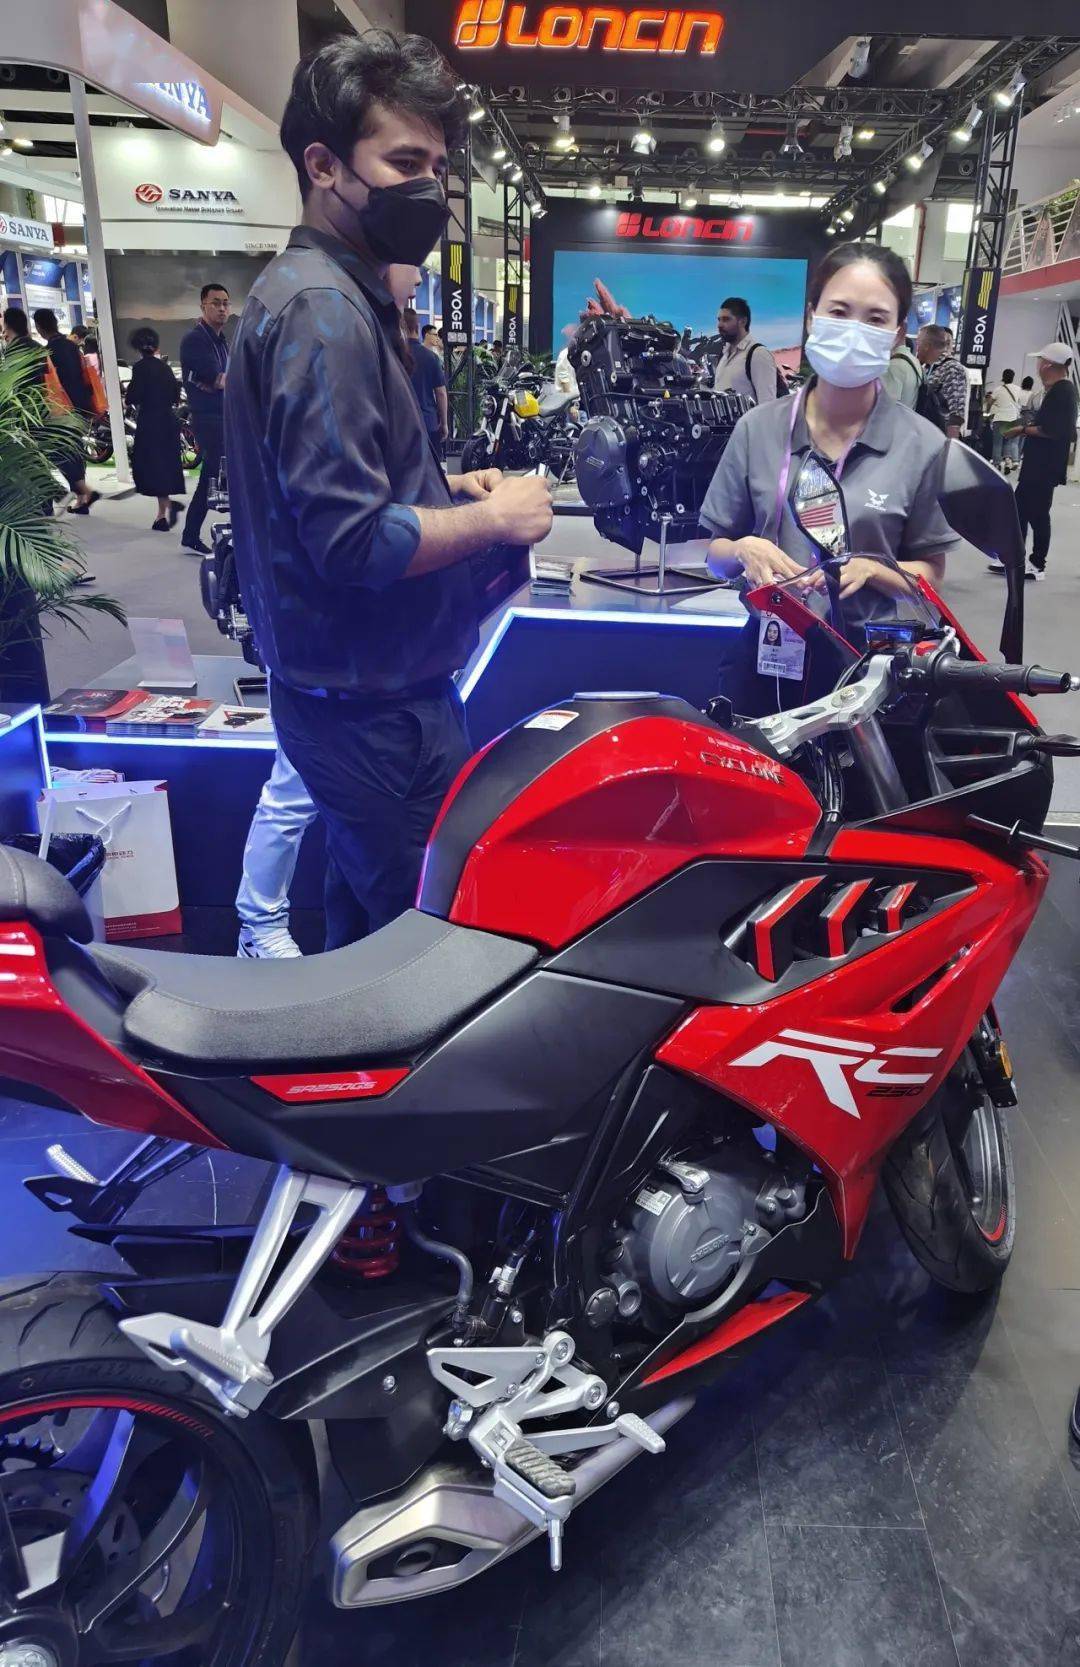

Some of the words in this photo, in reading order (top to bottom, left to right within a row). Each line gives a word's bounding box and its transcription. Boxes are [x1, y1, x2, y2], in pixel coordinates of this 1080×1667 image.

[506, 5, 724, 54] LONCIN
[169, 188, 238, 201] SANYA
[9, 221, 50, 242] SANYA
[451, 289, 463, 330] VOGE
[508, 316, 517, 344] VOGE
[972, 314, 988, 353] VOGE
[866, 1085, 925, 1098] 250
